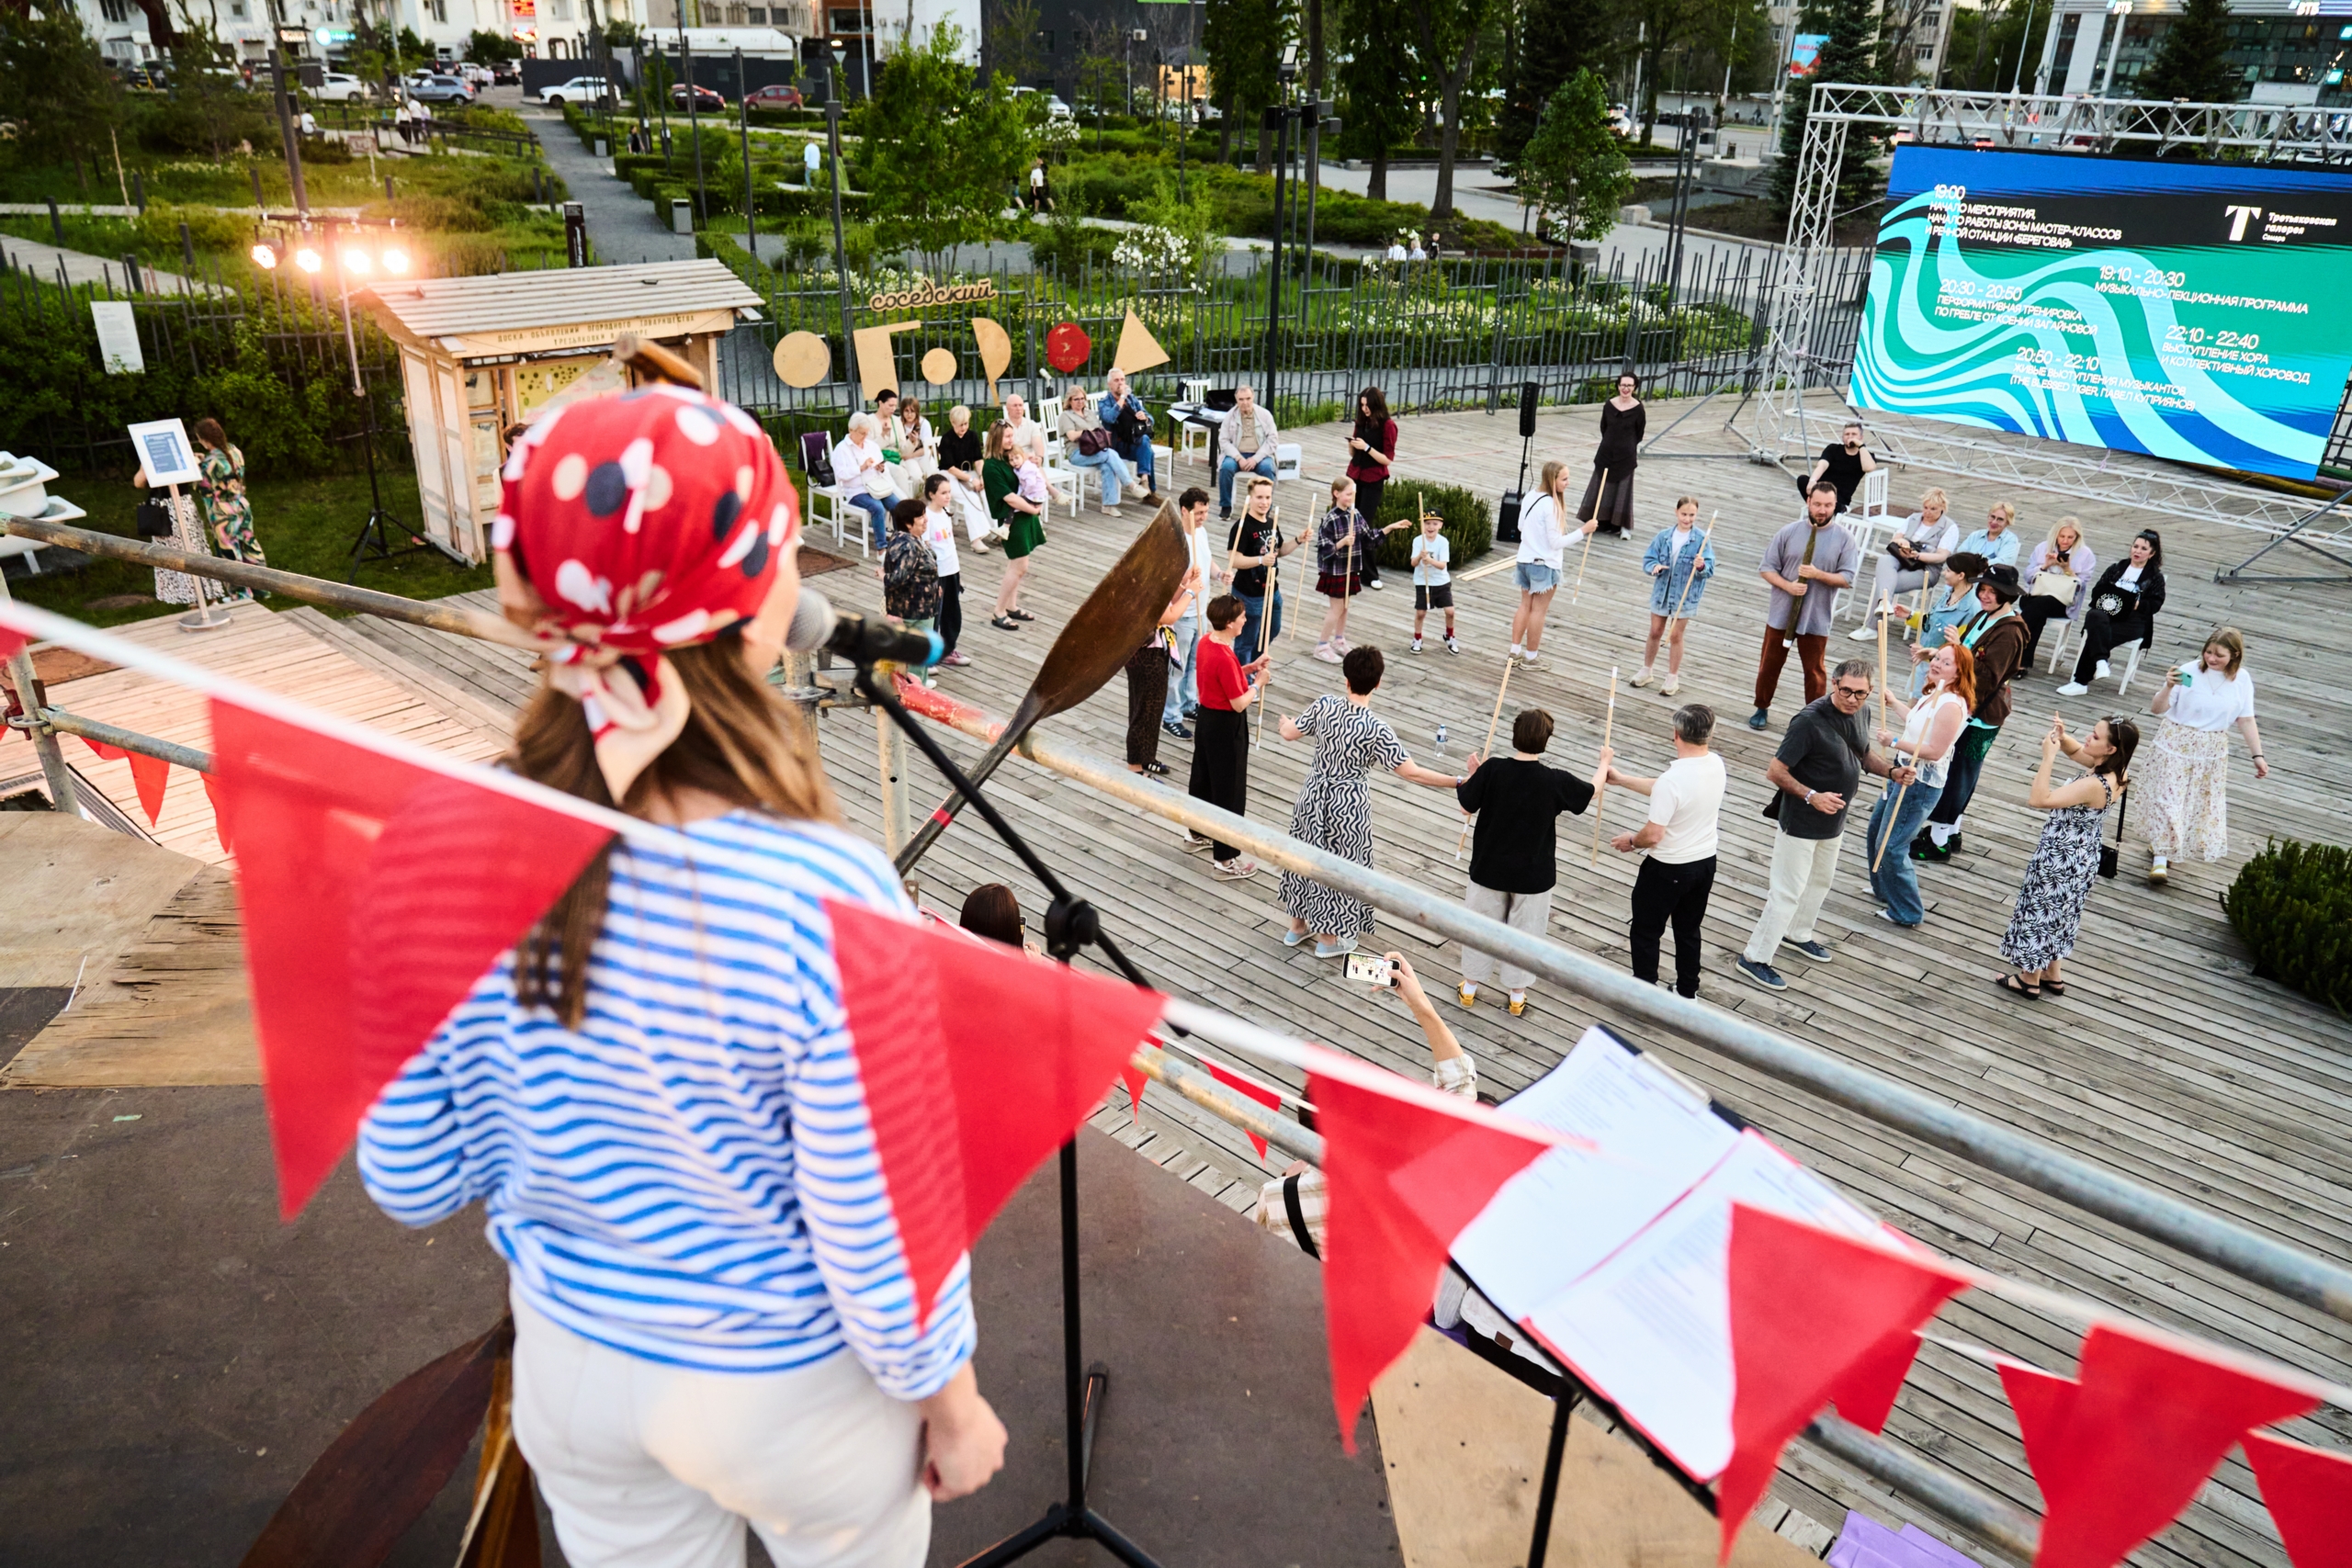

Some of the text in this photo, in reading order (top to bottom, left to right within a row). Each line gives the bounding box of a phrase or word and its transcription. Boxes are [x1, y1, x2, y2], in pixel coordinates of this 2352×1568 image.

[1934, 184, 1966, 200] 19:00
[1927, 212, 1965, 226] НАЧАЛО
[1964, 216, 2003, 229] РАБОТЫ
[2003, 220, 2031, 231] ЗОНЫ
[1929, 201, 2036, 220] НАЧАЛО МЕРОПРИЯТИЯ,
[2268, 212, 2337, 226] Третьяковская
[1925, 225, 1932, 234] И
[1932, 225, 1969, 239] РЕЧНОЙ
[1968, 230, 2014, 243] СТАНЦИИ
[2265, 224, 2305, 235] галерея
[2099, 265, 2132, 282] 19:10
[2143, 269, 2186, 288] 20:30
[872, 278, 997, 310] соседский
[1939, 278, 1976, 296] 20:30
[1985, 284, 2023, 301] 20:50
[1937, 294, 2083, 321] ПЕРФОРМАТИВНАЯ ТРЕНИРОВКА
[2239, 297, 2309, 314] ПРОГРАММА
[498, 333, 524, 343] ДОСКА
[588, 321, 631, 332] ОГОРОДНОГО
[1934, 306, 2098, 336] ПО ГРЕБЛЕ ОТ КСЕНИИ ЗАГАЙНОВОЙ
[2165, 324, 2205, 344] 22:10
[2215, 330, 2259, 350] 22:40
[2015, 346, 2053, 365] 20:50
[2063, 353, 2099, 371] 22:10
[2162, 342, 2269, 365] ВЫСТУПЛЕНИЕ ХОРА
[2013, 363, 2047, 377] ЖИВЫЕ
[2118, 378, 2187, 396] МУЗЫКАНТОВ
[2160, 355, 2311, 386] И КОЛЛЕКТИВНЫЙ ХОРОВОД
[2009, 374, 2099, 397] (THE BLESSED TIGER,
[2099, 388, 2196, 412] ПАВЕЛ КУПРИЯНОВ)
